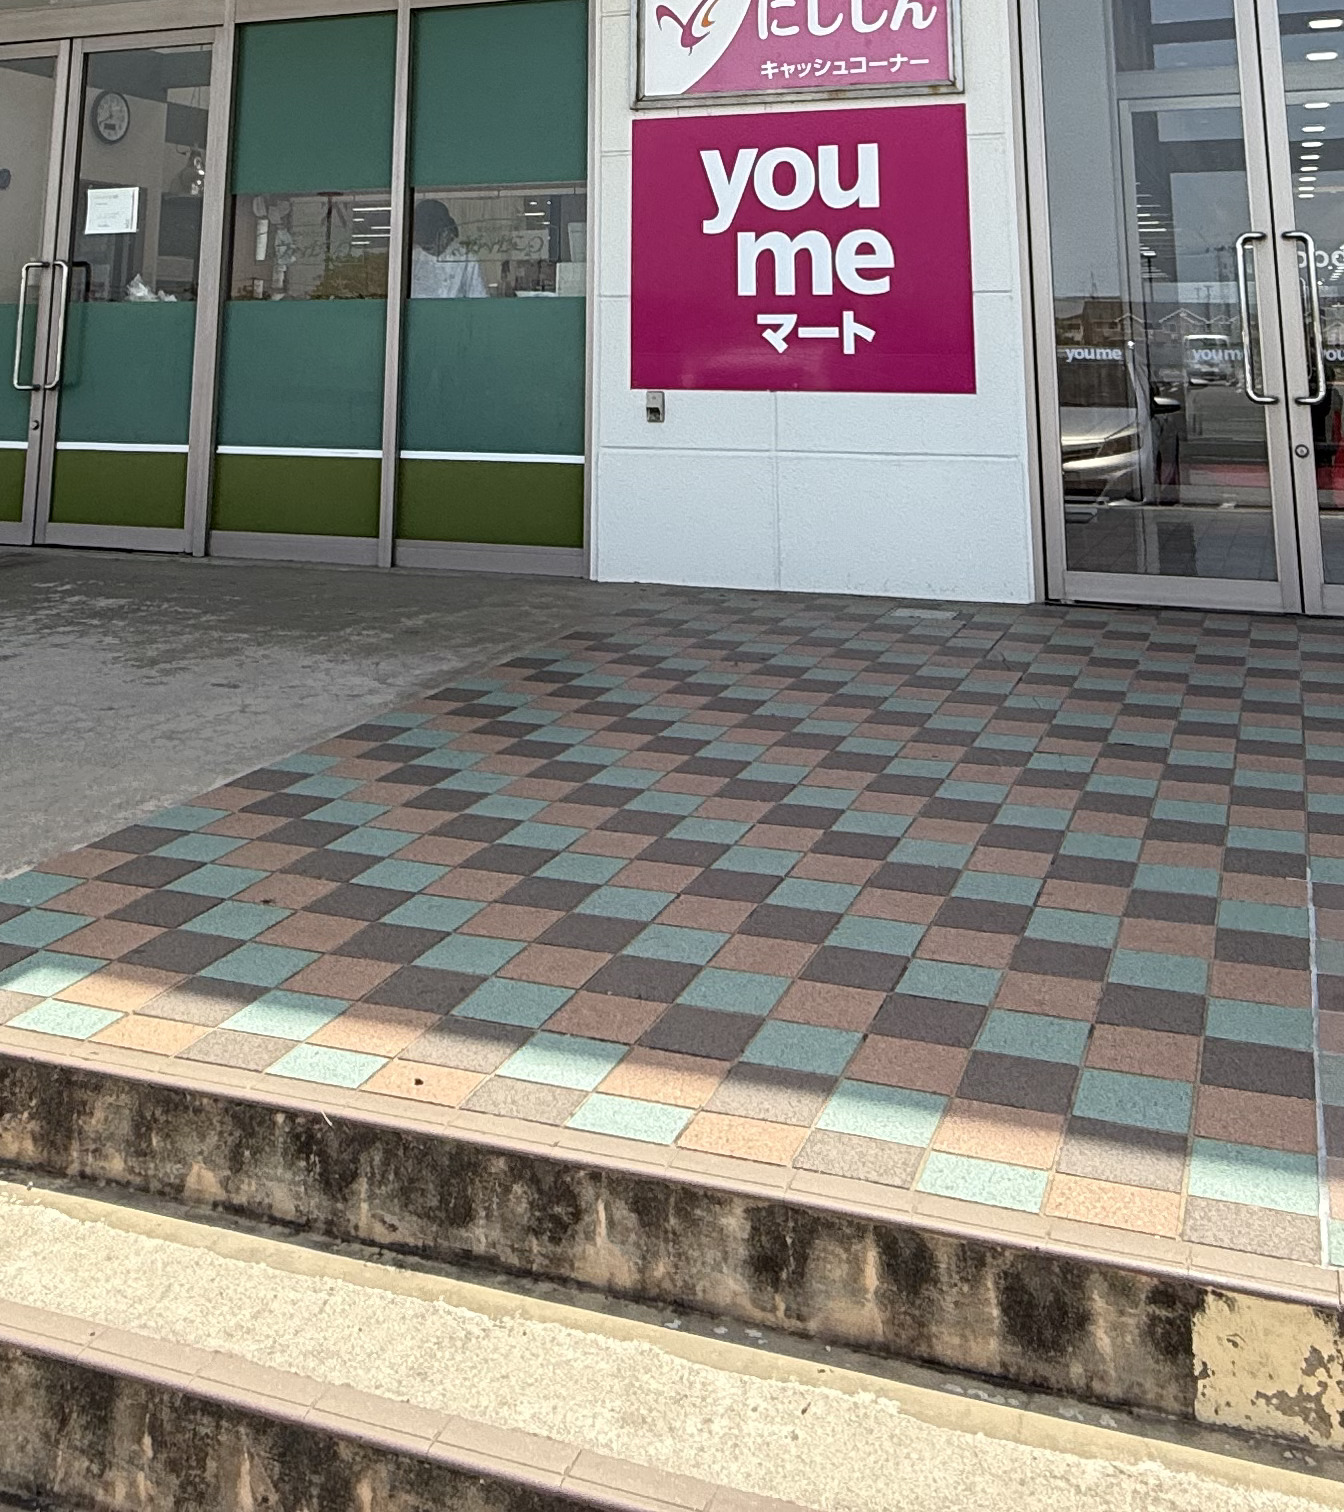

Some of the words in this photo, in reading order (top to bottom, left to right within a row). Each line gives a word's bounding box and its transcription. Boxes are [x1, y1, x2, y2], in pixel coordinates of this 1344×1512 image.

[760, 53, 930, 79] キャッシュコーナー
[699, 143, 881, 234] you
[737, 228, 896, 296] me
[757, 310, 876, 355] マート
[1191, 349, 1243, 363] youm
